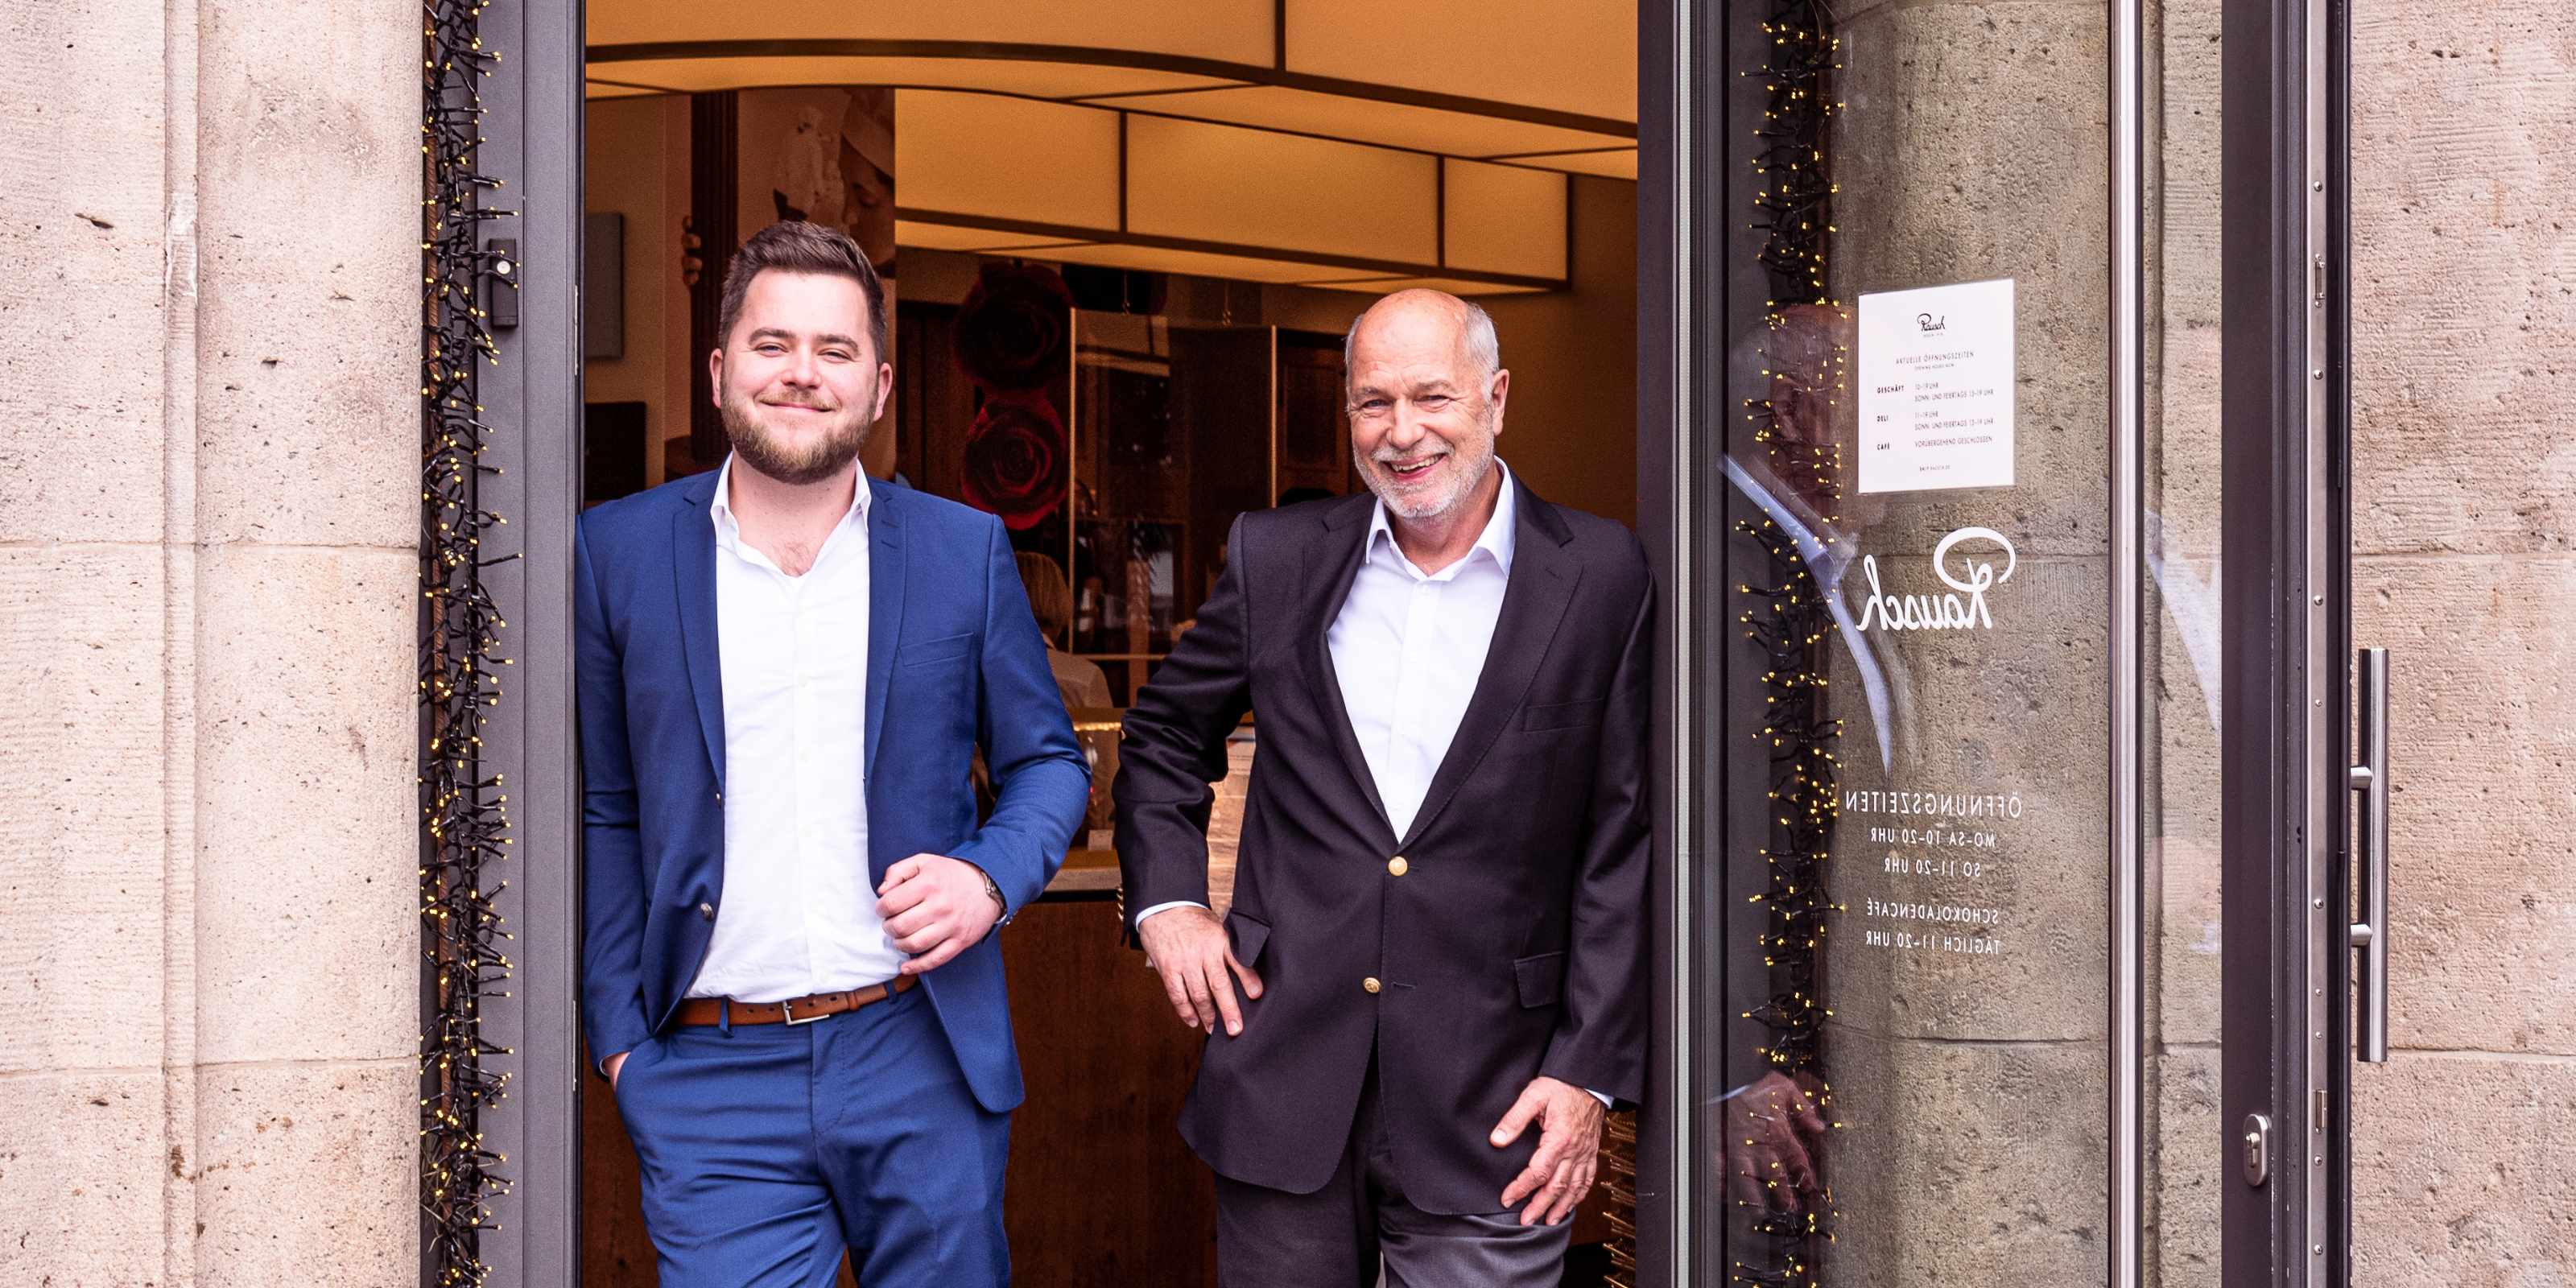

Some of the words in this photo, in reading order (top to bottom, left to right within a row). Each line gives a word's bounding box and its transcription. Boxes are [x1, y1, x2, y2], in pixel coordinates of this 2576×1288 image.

[1917, 313, 1945, 332] Rausch
[1924, 350, 1974, 362] ÖFFNUNGSZEITEN
[1876, 384, 1905, 394] GESCHÄFT
[1914, 438, 1955, 448] VORÜBERGEHEND
[1957, 436, 1993, 445] GESCHLOSSEN
